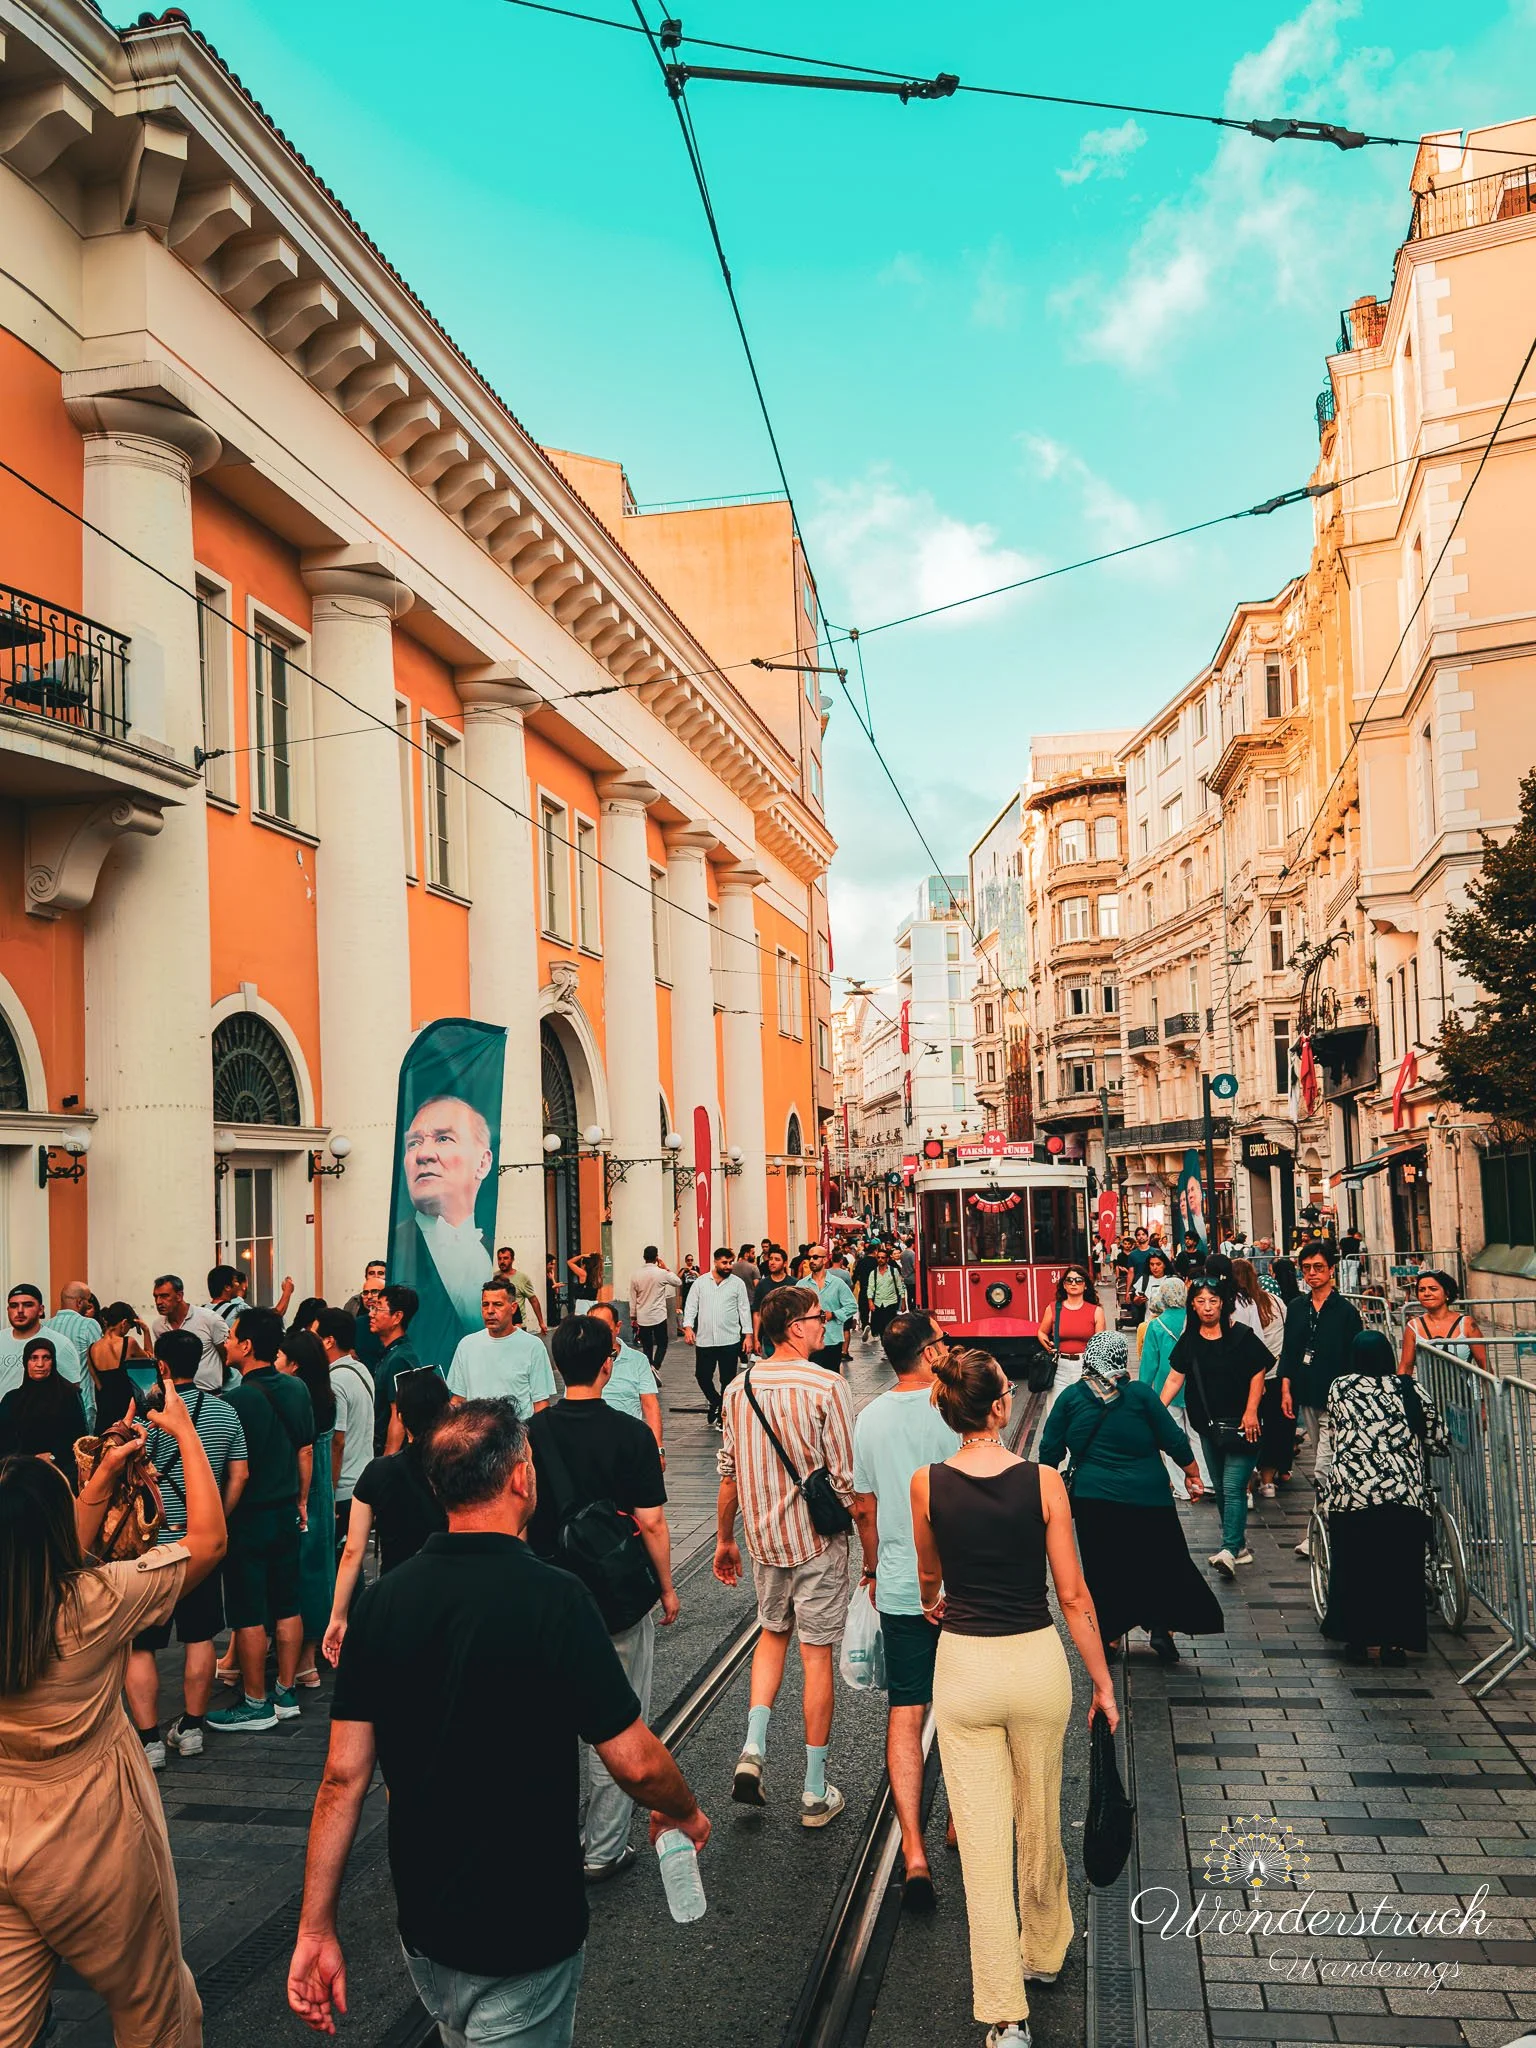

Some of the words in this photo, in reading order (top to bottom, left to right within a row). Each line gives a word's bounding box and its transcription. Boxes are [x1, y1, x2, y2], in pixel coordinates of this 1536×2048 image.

[988, 1135, 1001, 1144] 34
[960, 1145, 993, 1156] TAKSİM
[1002, 1145, 1031, 1155] TÜNEL
[936, 1272, 946, 1286] 34
